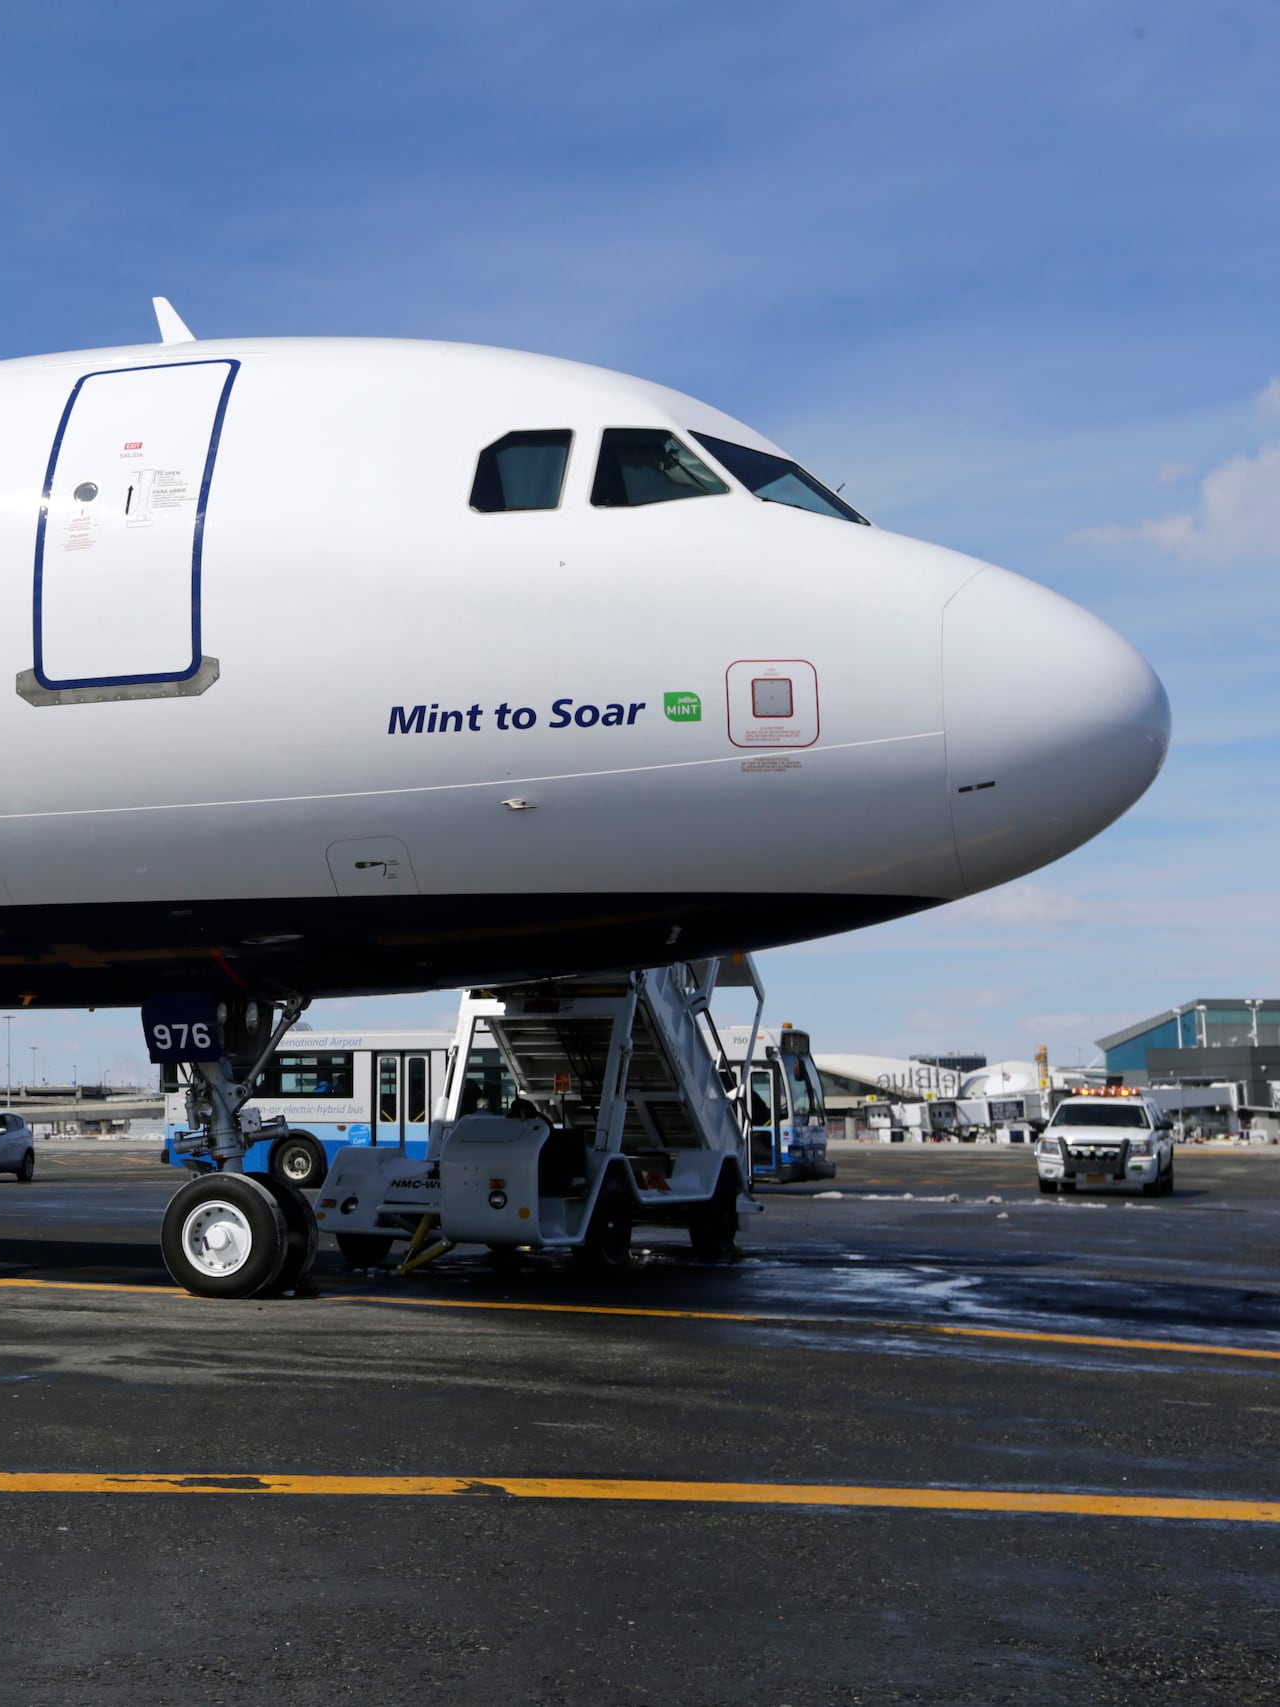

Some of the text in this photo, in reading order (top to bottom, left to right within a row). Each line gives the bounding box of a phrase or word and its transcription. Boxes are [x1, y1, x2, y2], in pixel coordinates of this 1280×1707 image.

[388, 698, 646, 734] Mint to Soar
[666, 704, 699, 716] MINT
[153, 1022, 211, 1050] 976
[330, 1037, 362, 1050] Airport
[282, 1104, 346, 1116] electric-hybrid
[347, 1104, 364, 1115] bus
